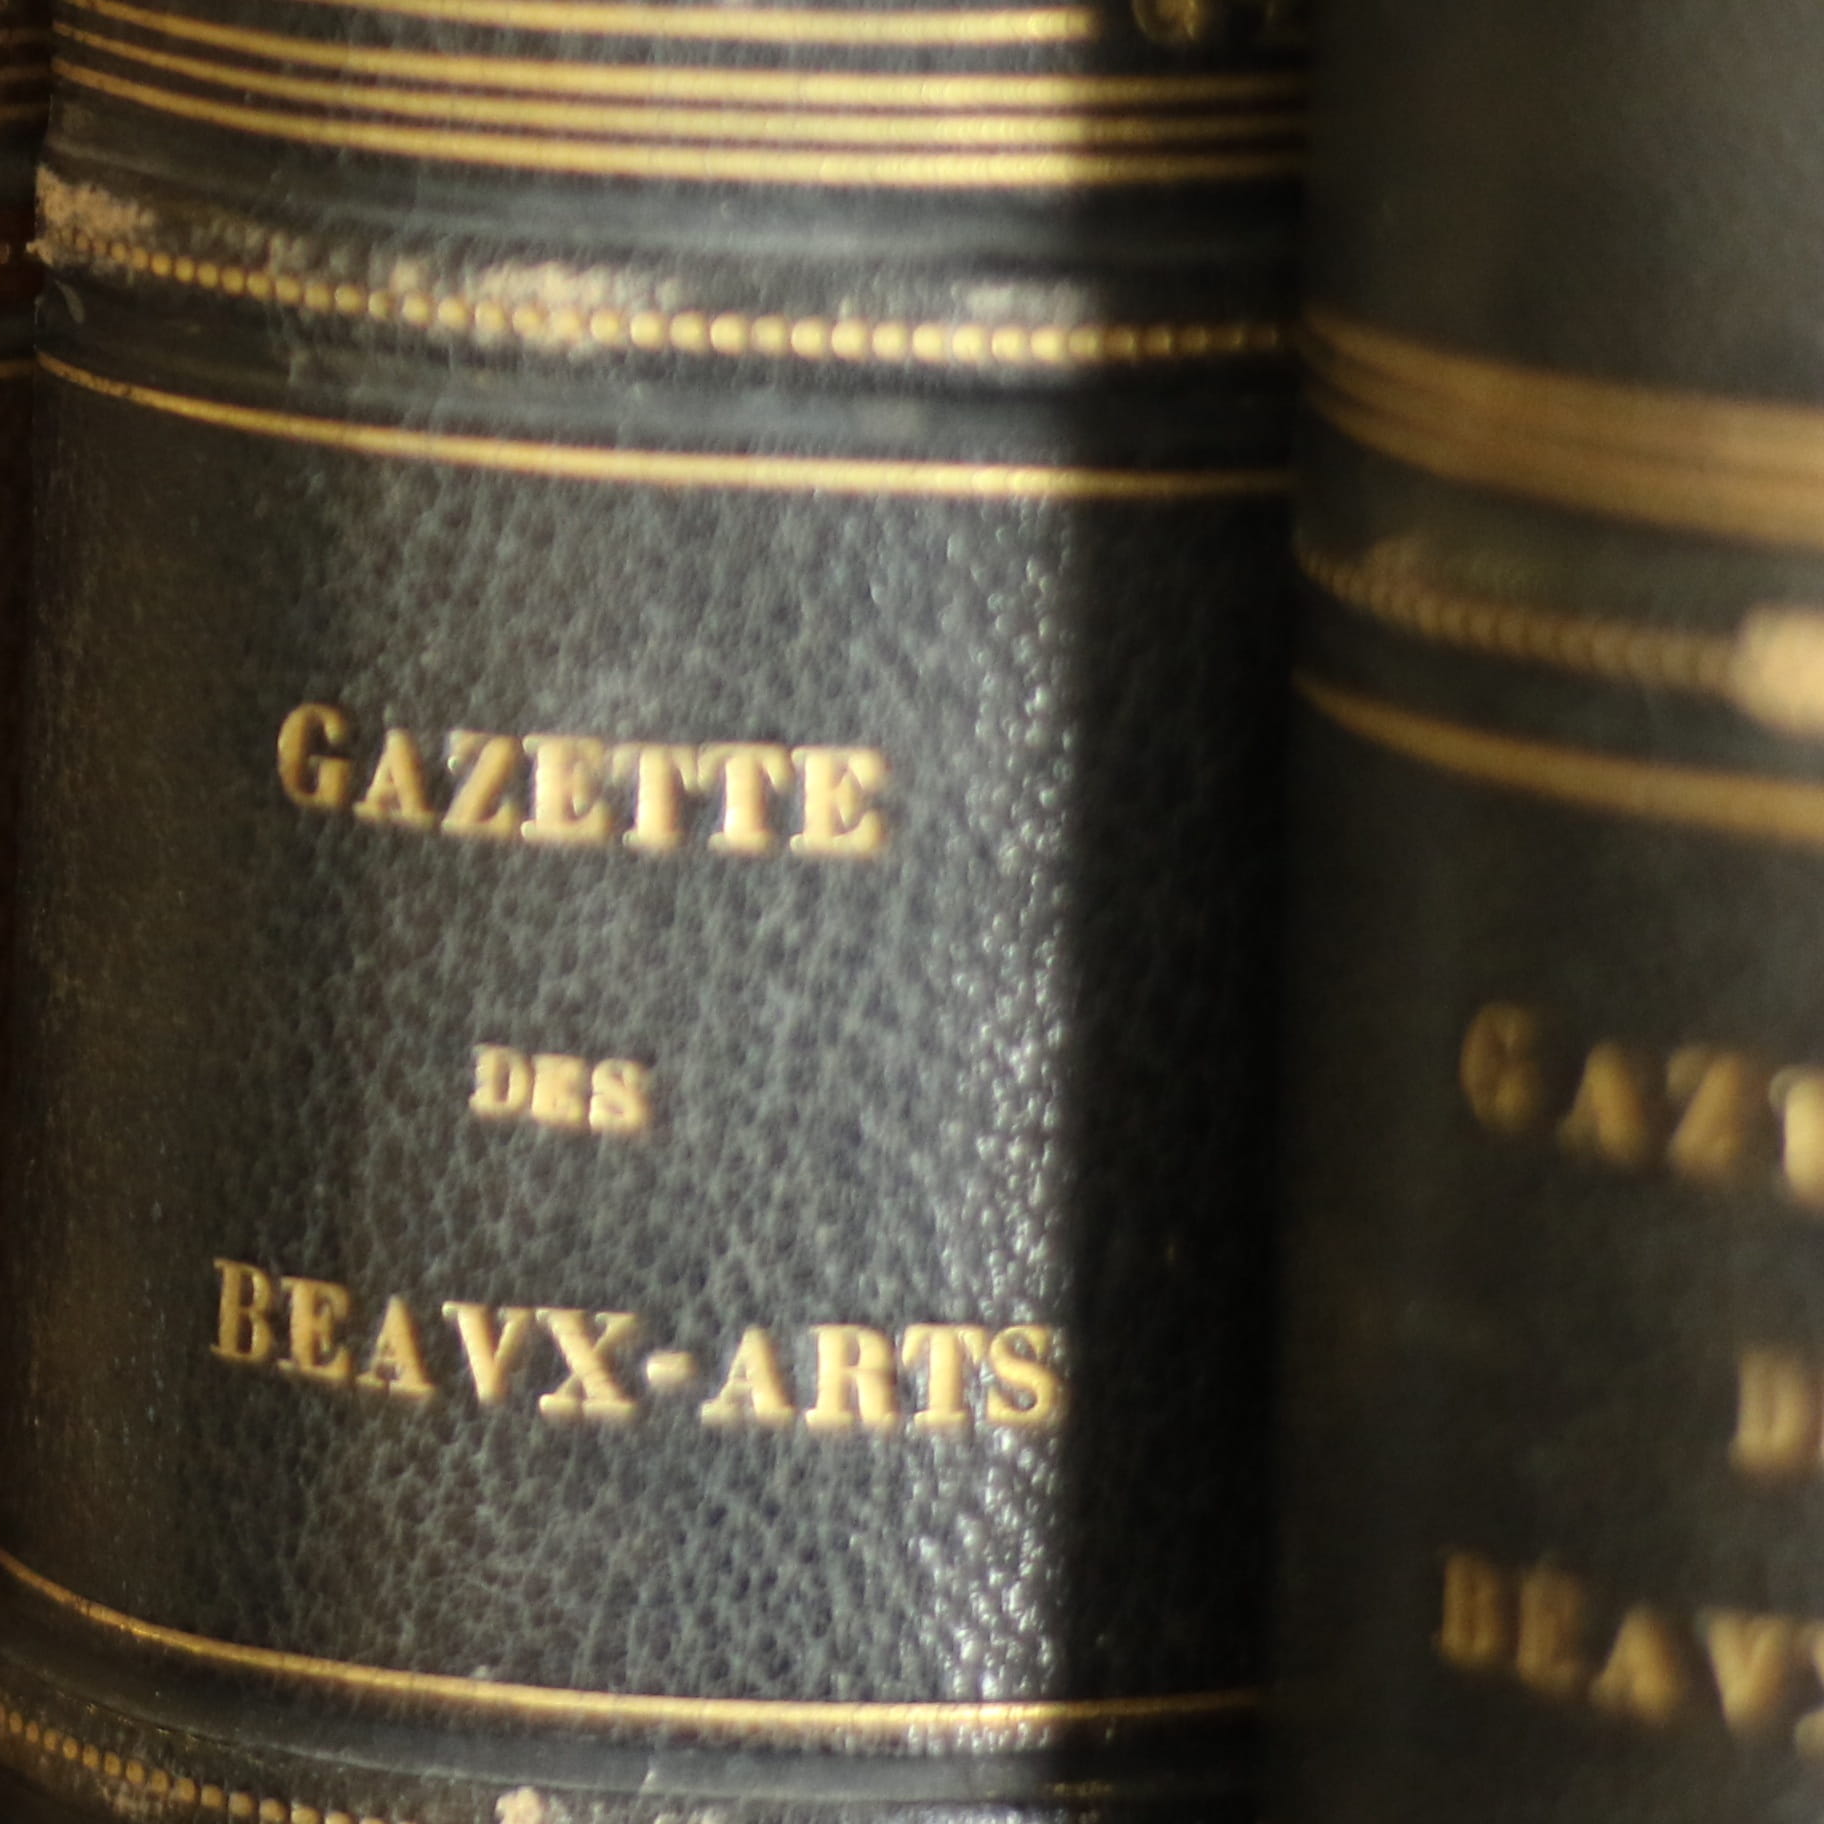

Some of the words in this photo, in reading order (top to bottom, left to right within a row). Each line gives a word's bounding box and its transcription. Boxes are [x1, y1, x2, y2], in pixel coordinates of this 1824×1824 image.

[277, 702, 886, 856] GAZETTE
[469, 1044, 648, 1132] DES
[212, 1258, 1064, 1430] BEAVX-ARTS
[1438, 1552, 1824, 1760] BEAV
